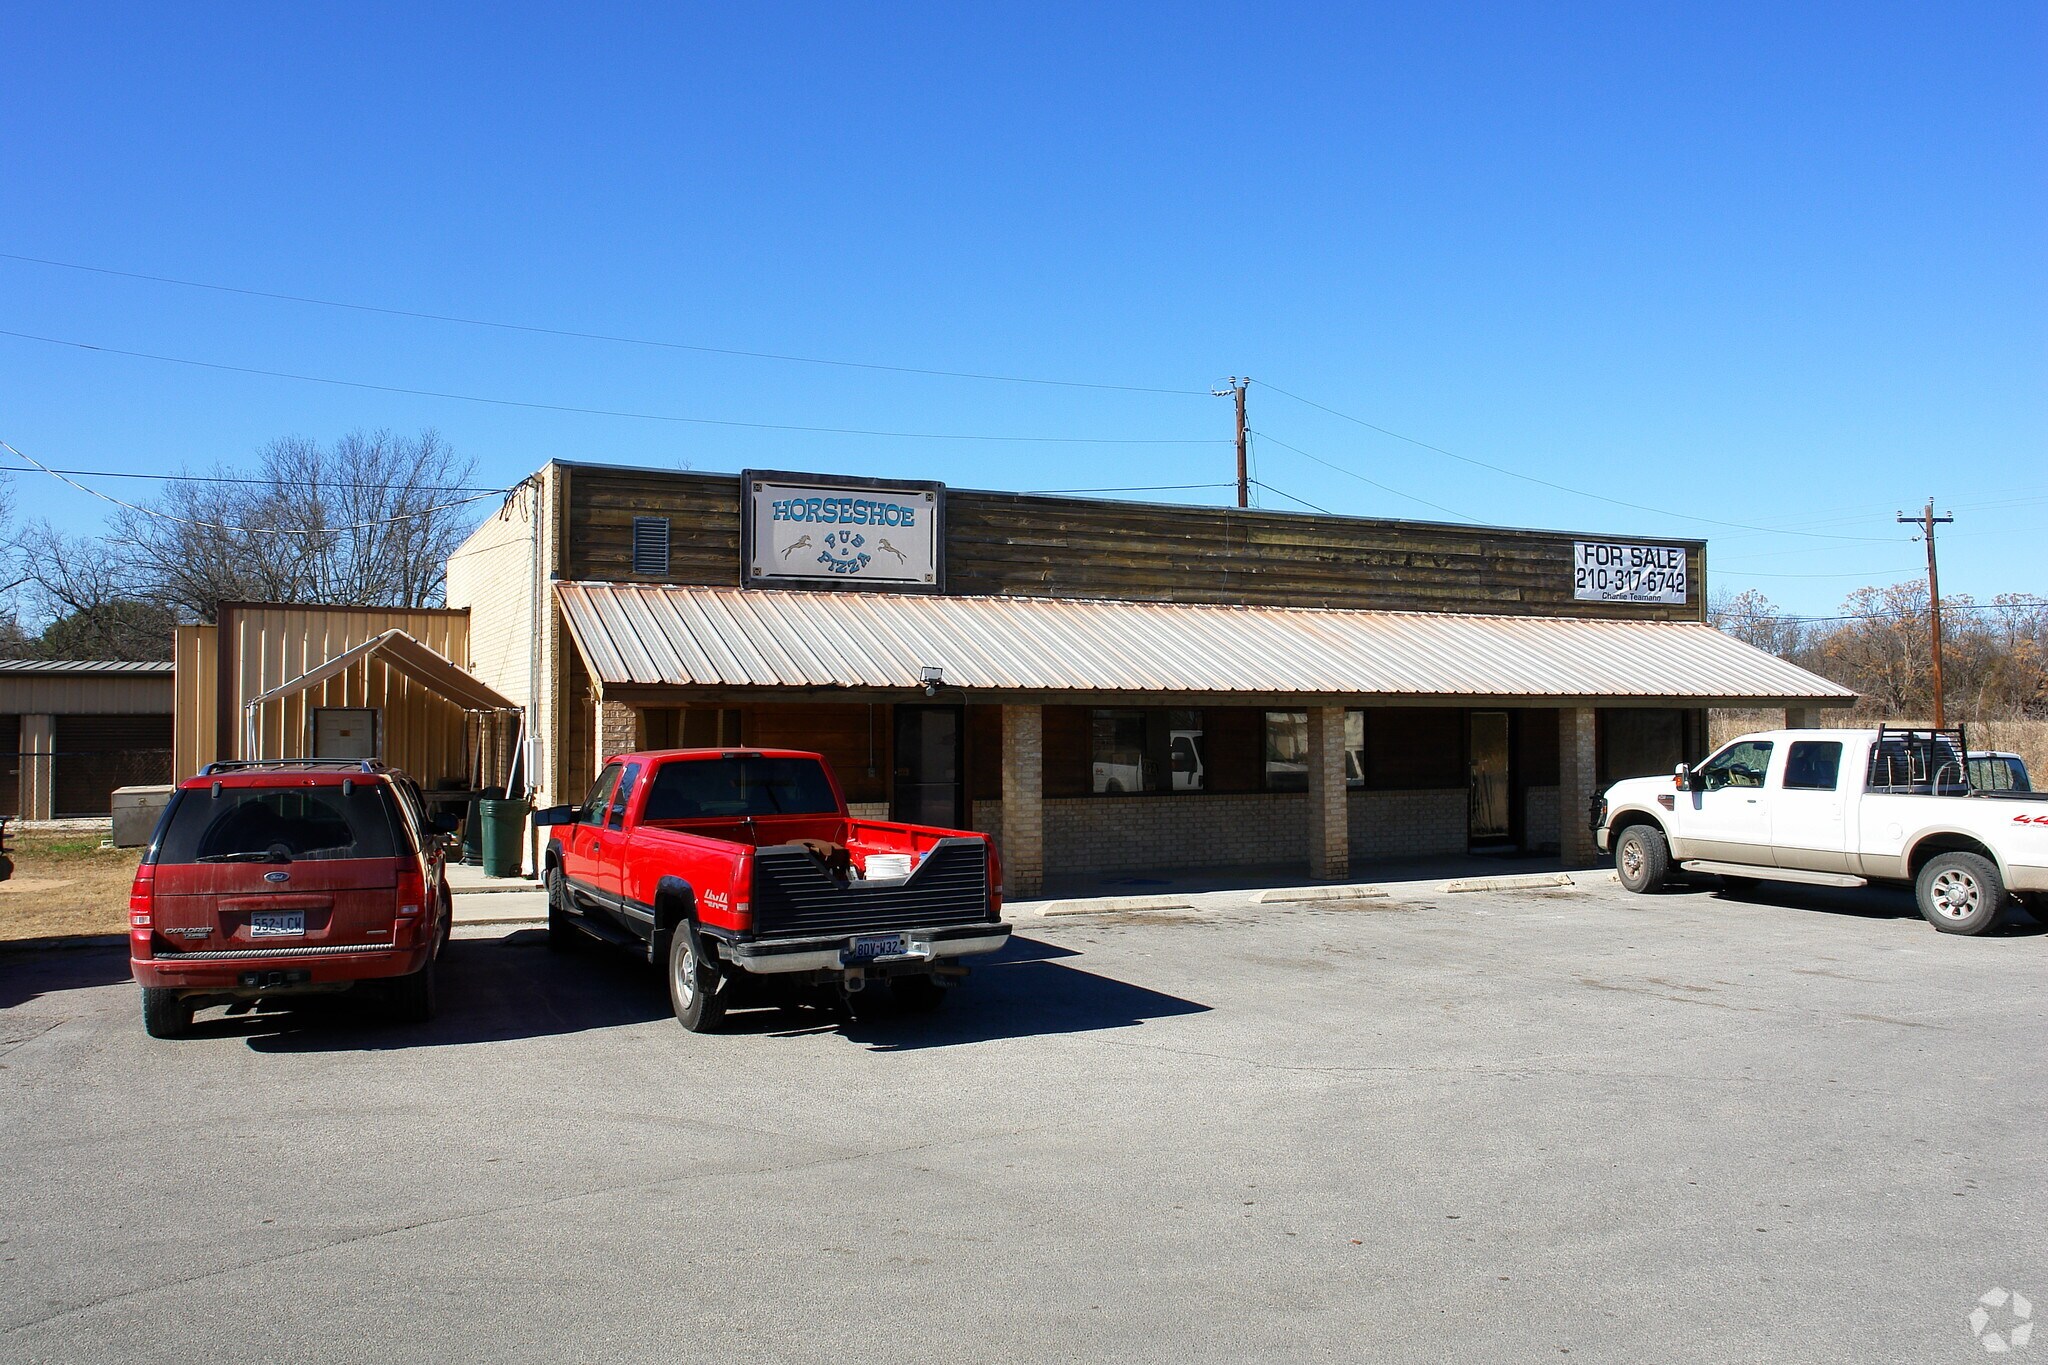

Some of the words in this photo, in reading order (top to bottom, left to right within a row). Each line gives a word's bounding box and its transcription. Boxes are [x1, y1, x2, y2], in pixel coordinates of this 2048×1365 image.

[772, 497, 915, 527] HORSESHOE
[824, 530, 866, 549] PUB
[817, 550, 871, 574] PIZZA
[841, 547, 849, 556] &
[1584, 544, 1623, 566] FOR
[1630, 547, 1678, 569] SALE
[1576, 567, 1685, 593] 210-317-6742
[1602, 591, 1628, 600] Charlie
[164, 926, 214, 934] EXPLORER
